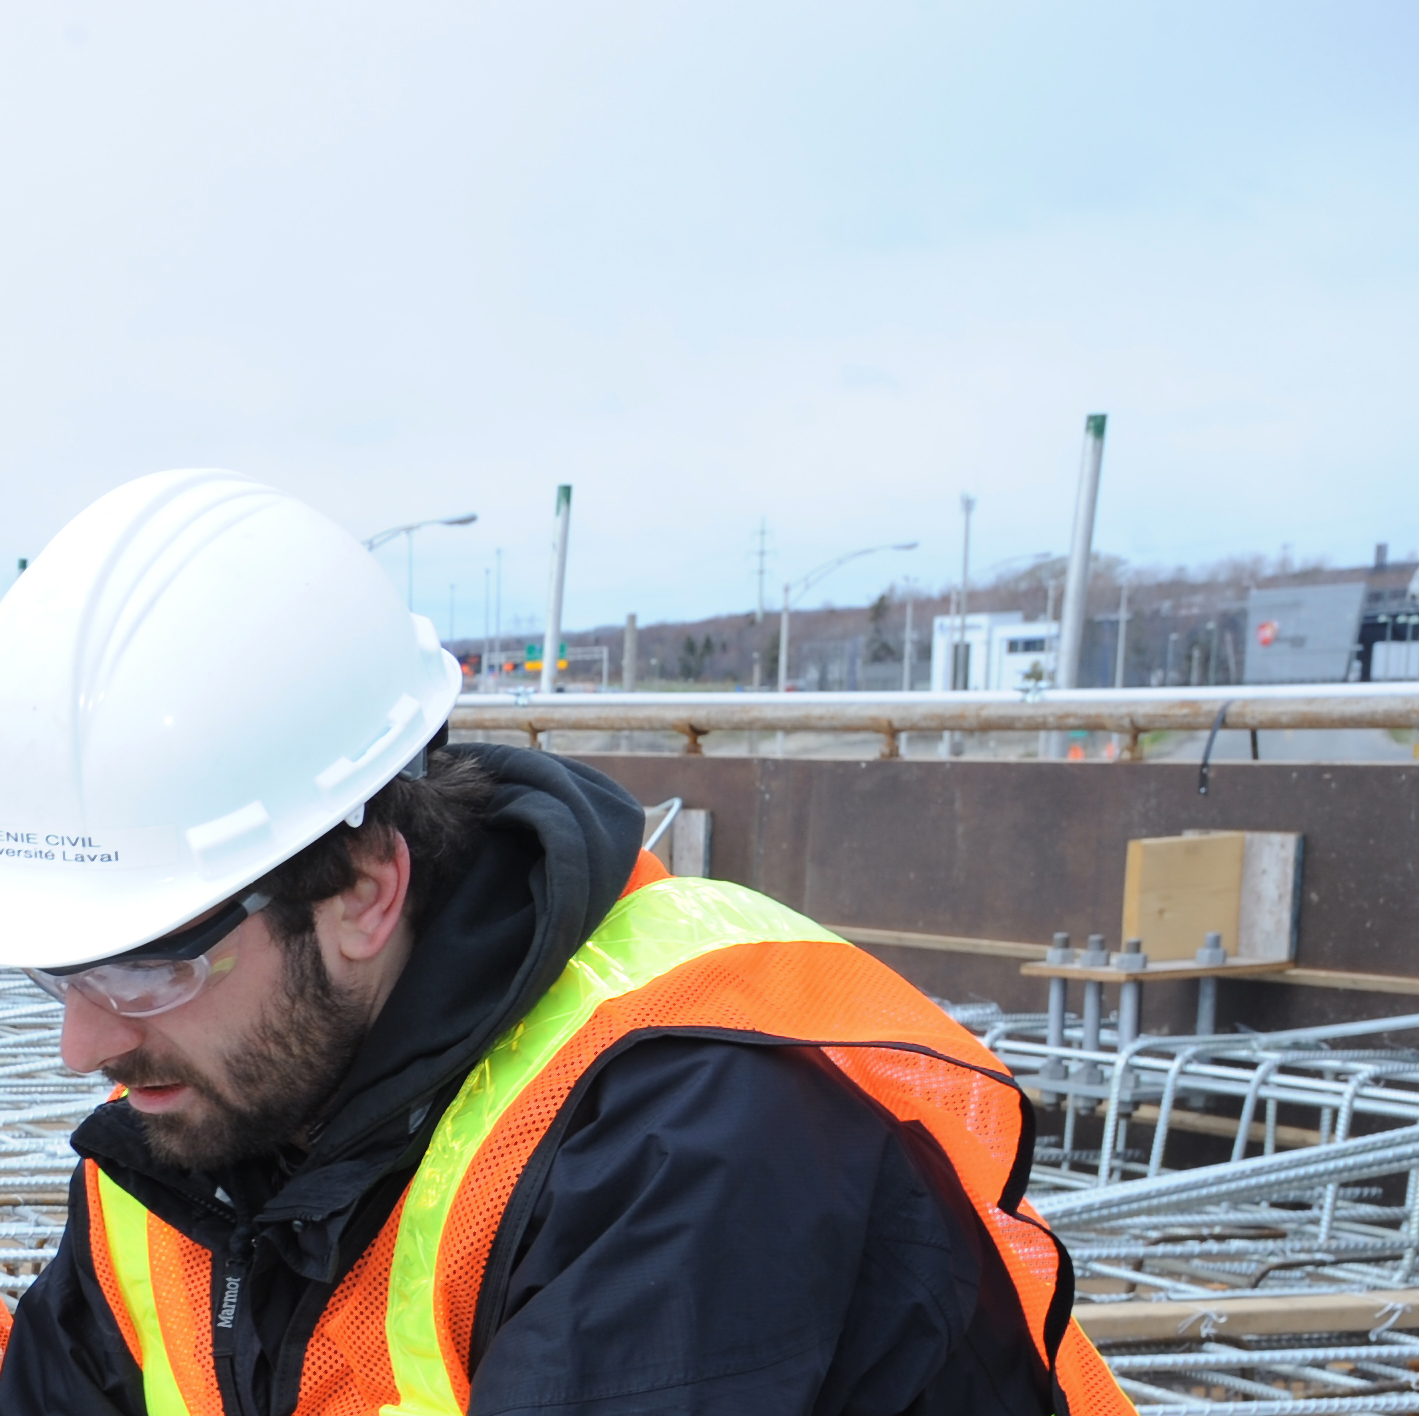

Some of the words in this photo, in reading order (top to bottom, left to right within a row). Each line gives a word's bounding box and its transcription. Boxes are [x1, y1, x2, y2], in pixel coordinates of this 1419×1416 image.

[45, 834, 101, 848] CIVIL
[63, 850, 119, 862] Laval
[216, 1276, 241, 1329] Marmot
